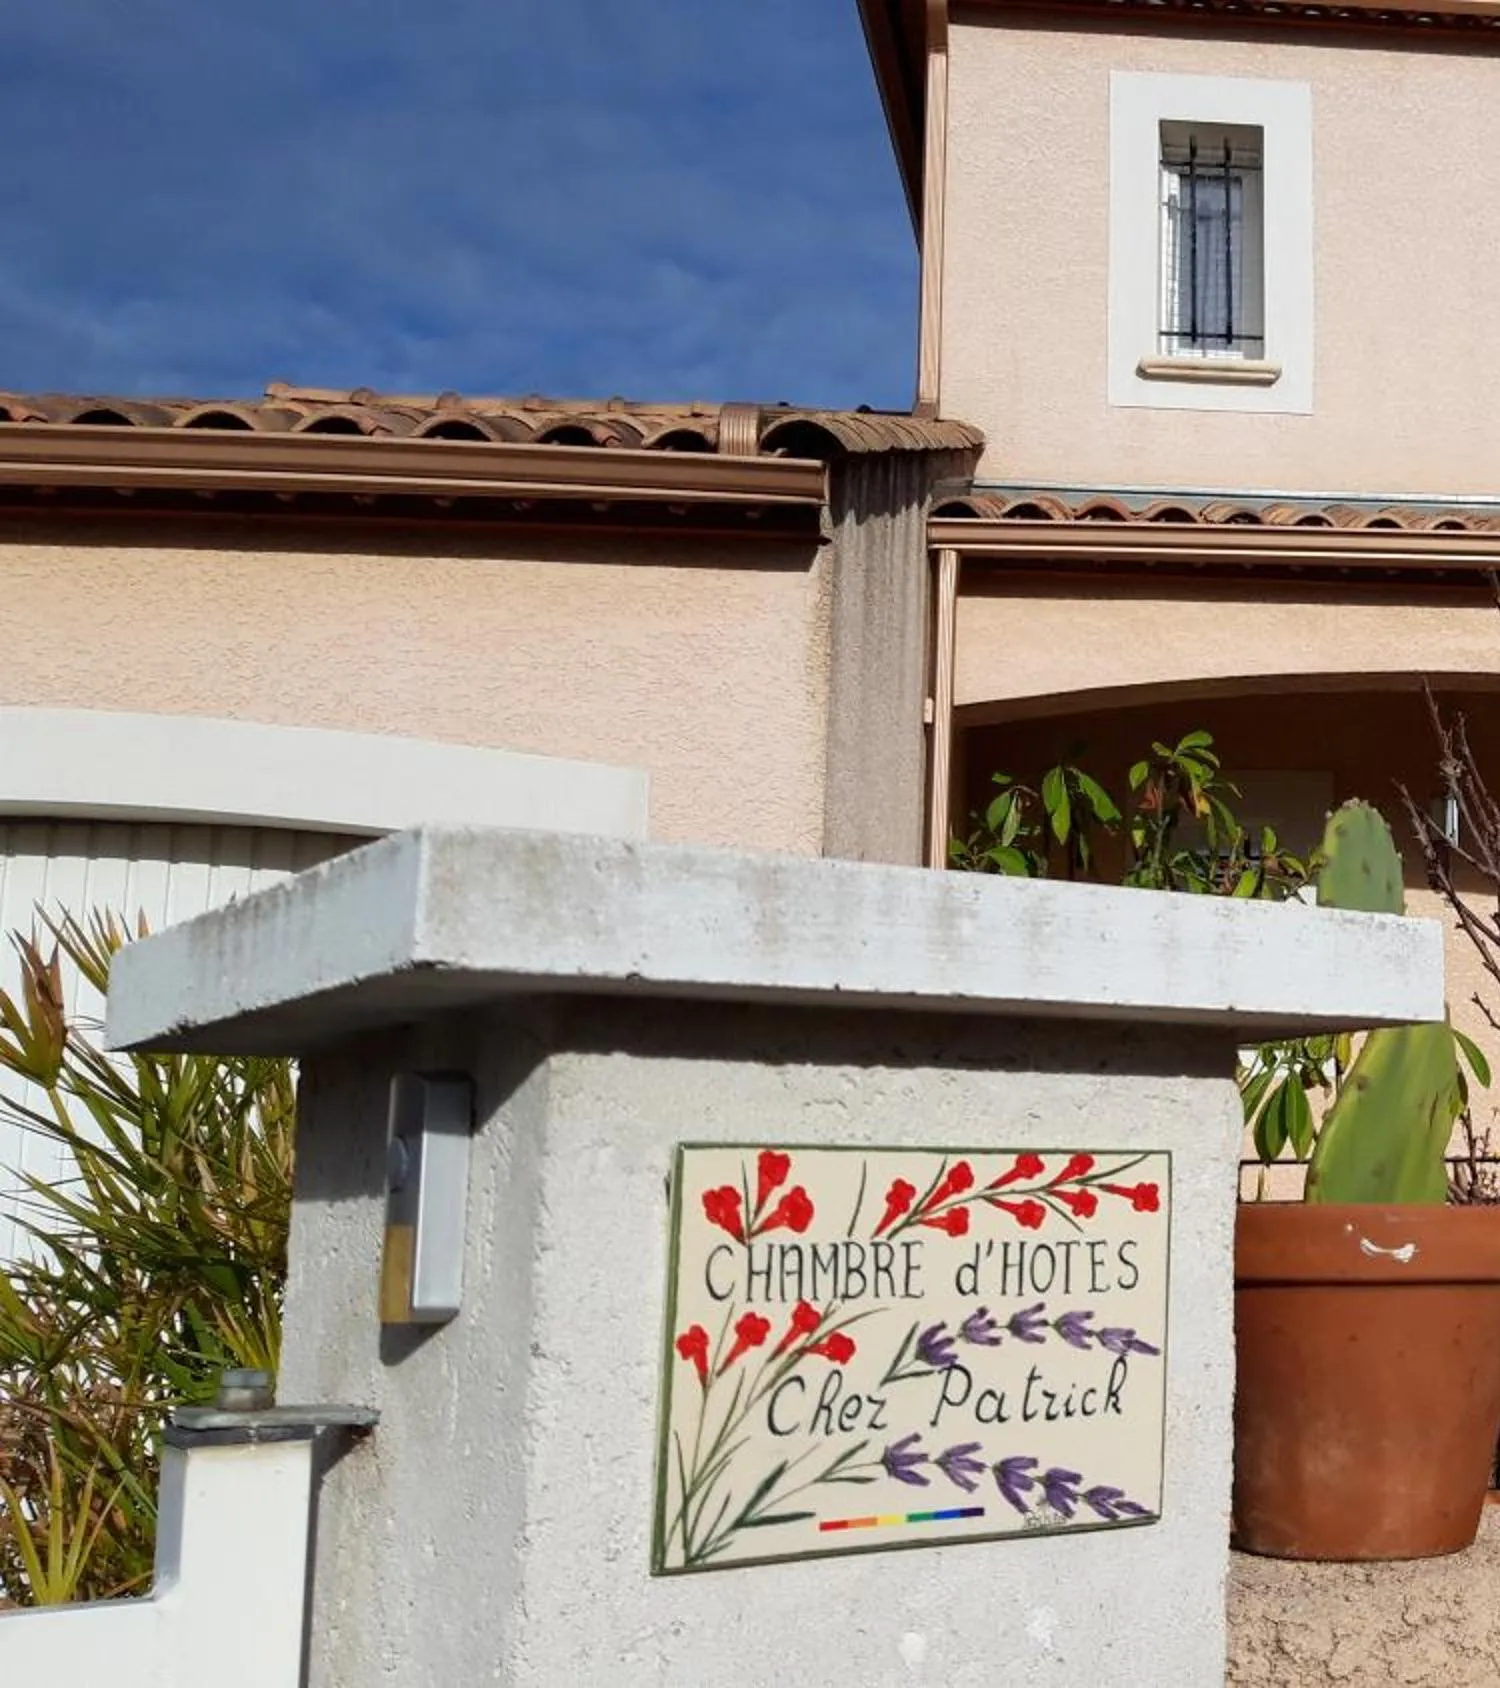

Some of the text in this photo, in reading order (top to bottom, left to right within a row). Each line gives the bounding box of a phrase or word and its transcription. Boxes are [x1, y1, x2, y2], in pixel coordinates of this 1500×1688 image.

[705, 1239, 1140, 1302] CHAMBRE d'HOTES
[766, 1354, 1128, 1437] Chez Patrick
